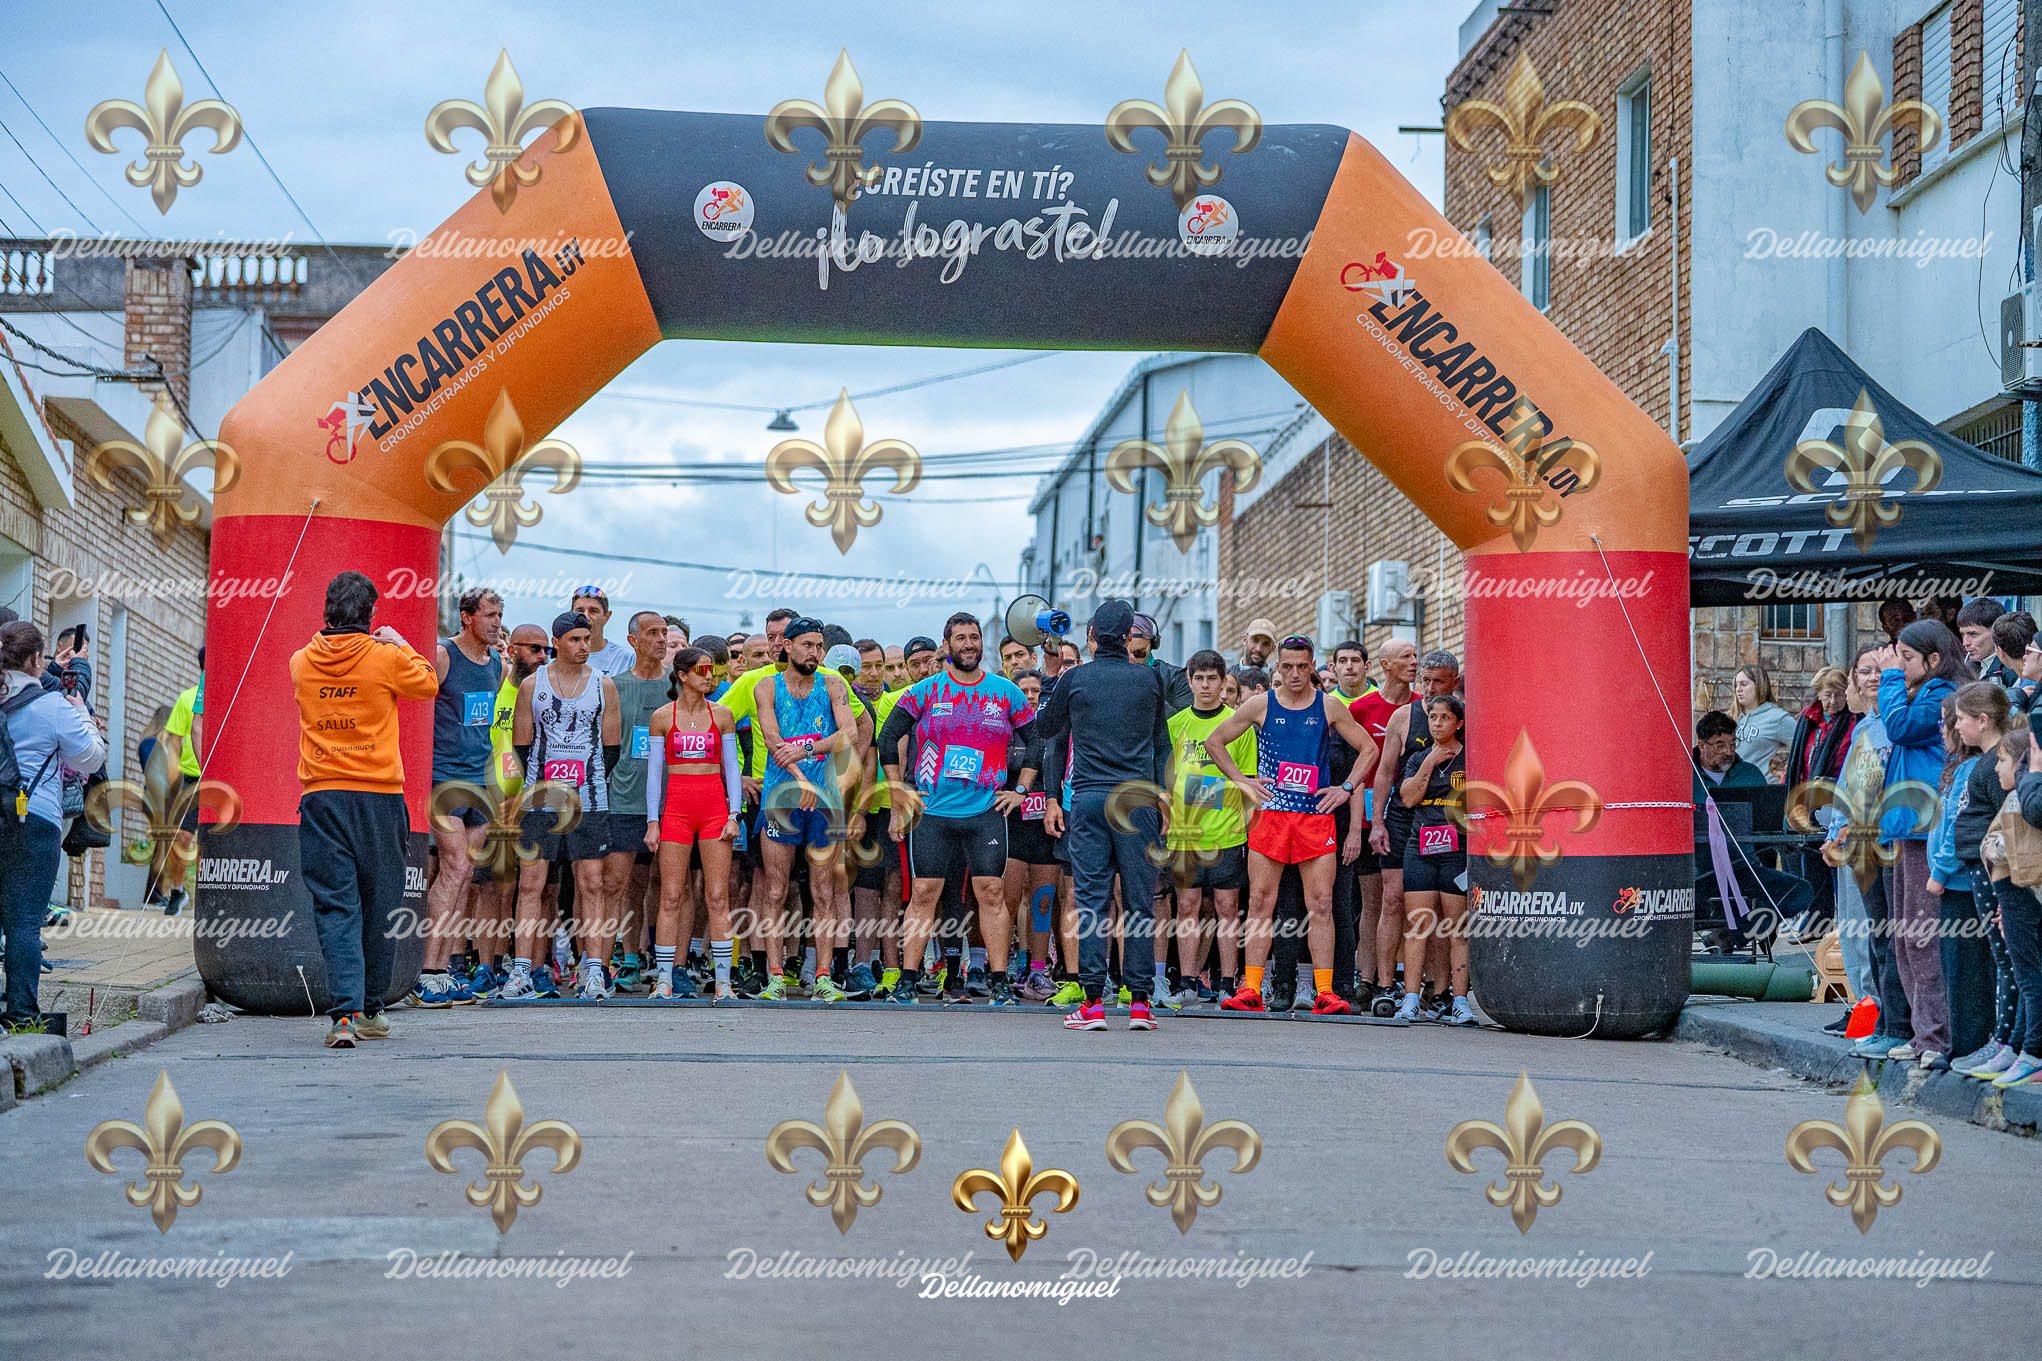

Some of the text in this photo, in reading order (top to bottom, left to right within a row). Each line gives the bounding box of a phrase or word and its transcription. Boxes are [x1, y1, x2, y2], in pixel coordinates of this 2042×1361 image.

[846, 161, 1074, 200] ¿CREÍSTE EN TÍ?
[379, 287, 571, 453] CRONOMETRAMOS Y DIFUNDIMOS
[1356, 313, 1535, 486] CRONOMETRAMOS Y DIFUNDIMOS
[320, 686, 358, 699] STAFF
[471, 702, 489, 717] 413
[317, 718, 356, 731] SALUS
[682, 735, 706, 750] 178
[550, 763, 579, 779] 234
[950, 755, 977, 772] 425
[1283, 766, 1312, 785] 207
[1190, 783, 1217, 800] 406
[1425, 829, 1452, 846] 224
